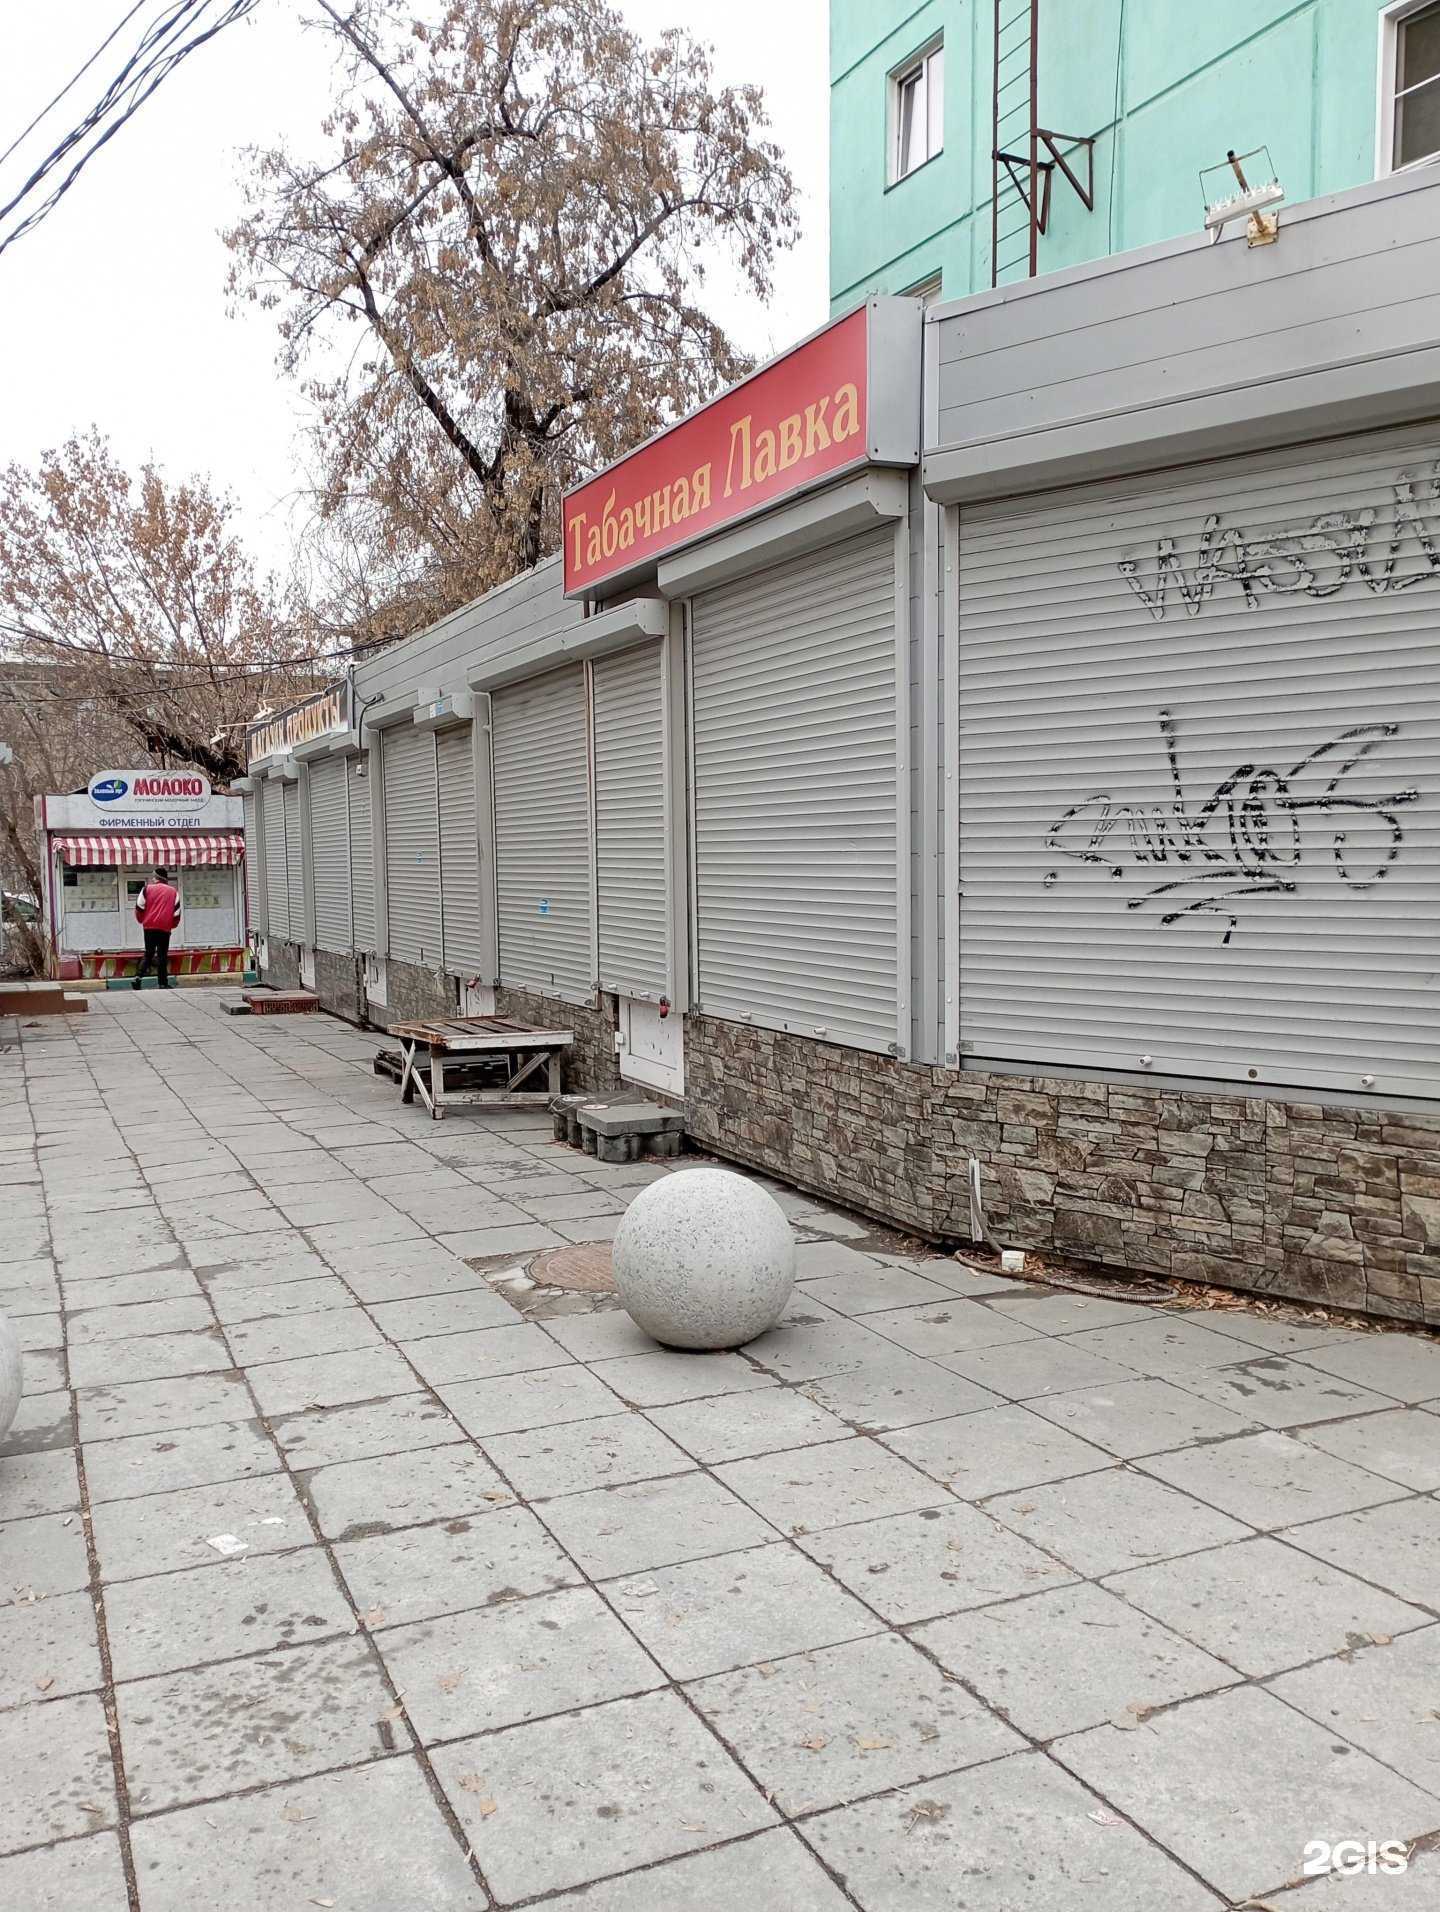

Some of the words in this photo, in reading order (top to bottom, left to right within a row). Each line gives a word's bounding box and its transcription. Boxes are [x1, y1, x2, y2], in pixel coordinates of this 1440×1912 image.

[568, 462, 713, 572] Табачная
[723, 383, 860, 498] Лавка
[133, 778, 203, 796] МОЛОКО
[99, 816, 165, 827] ФИРМЕННЫЙ
[168, 818, 200, 829] ОТДЕЛ
